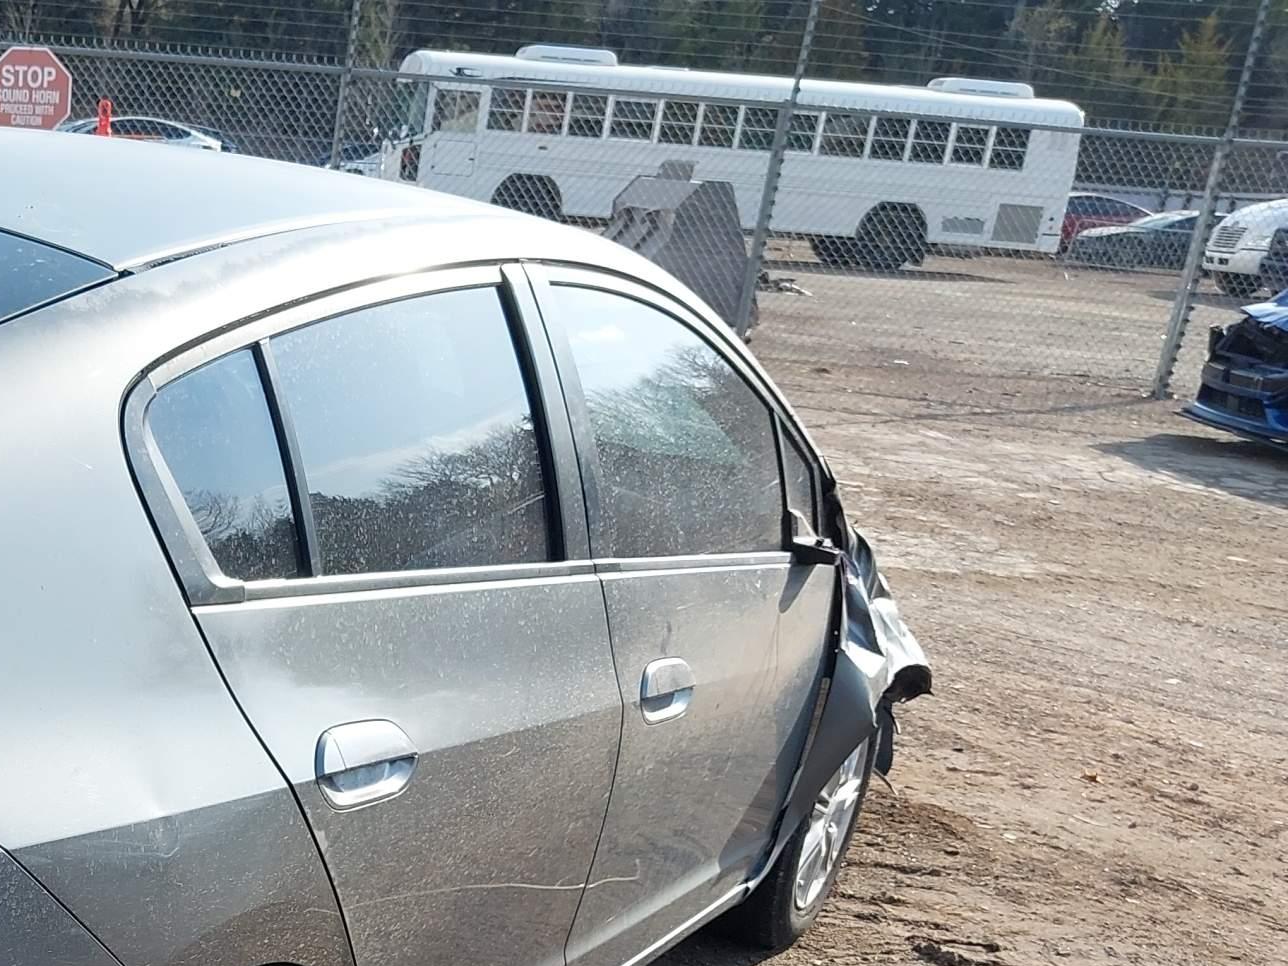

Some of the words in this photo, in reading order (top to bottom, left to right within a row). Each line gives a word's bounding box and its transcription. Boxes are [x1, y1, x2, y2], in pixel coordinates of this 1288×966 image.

[1, 65, 57, 88] STOP
[31, 89, 60, 104] HORN
[0, 103, 33, 115] PROCEED
[34, 105, 55, 116] WITH
[10, 114, 43, 126] CAUTION
